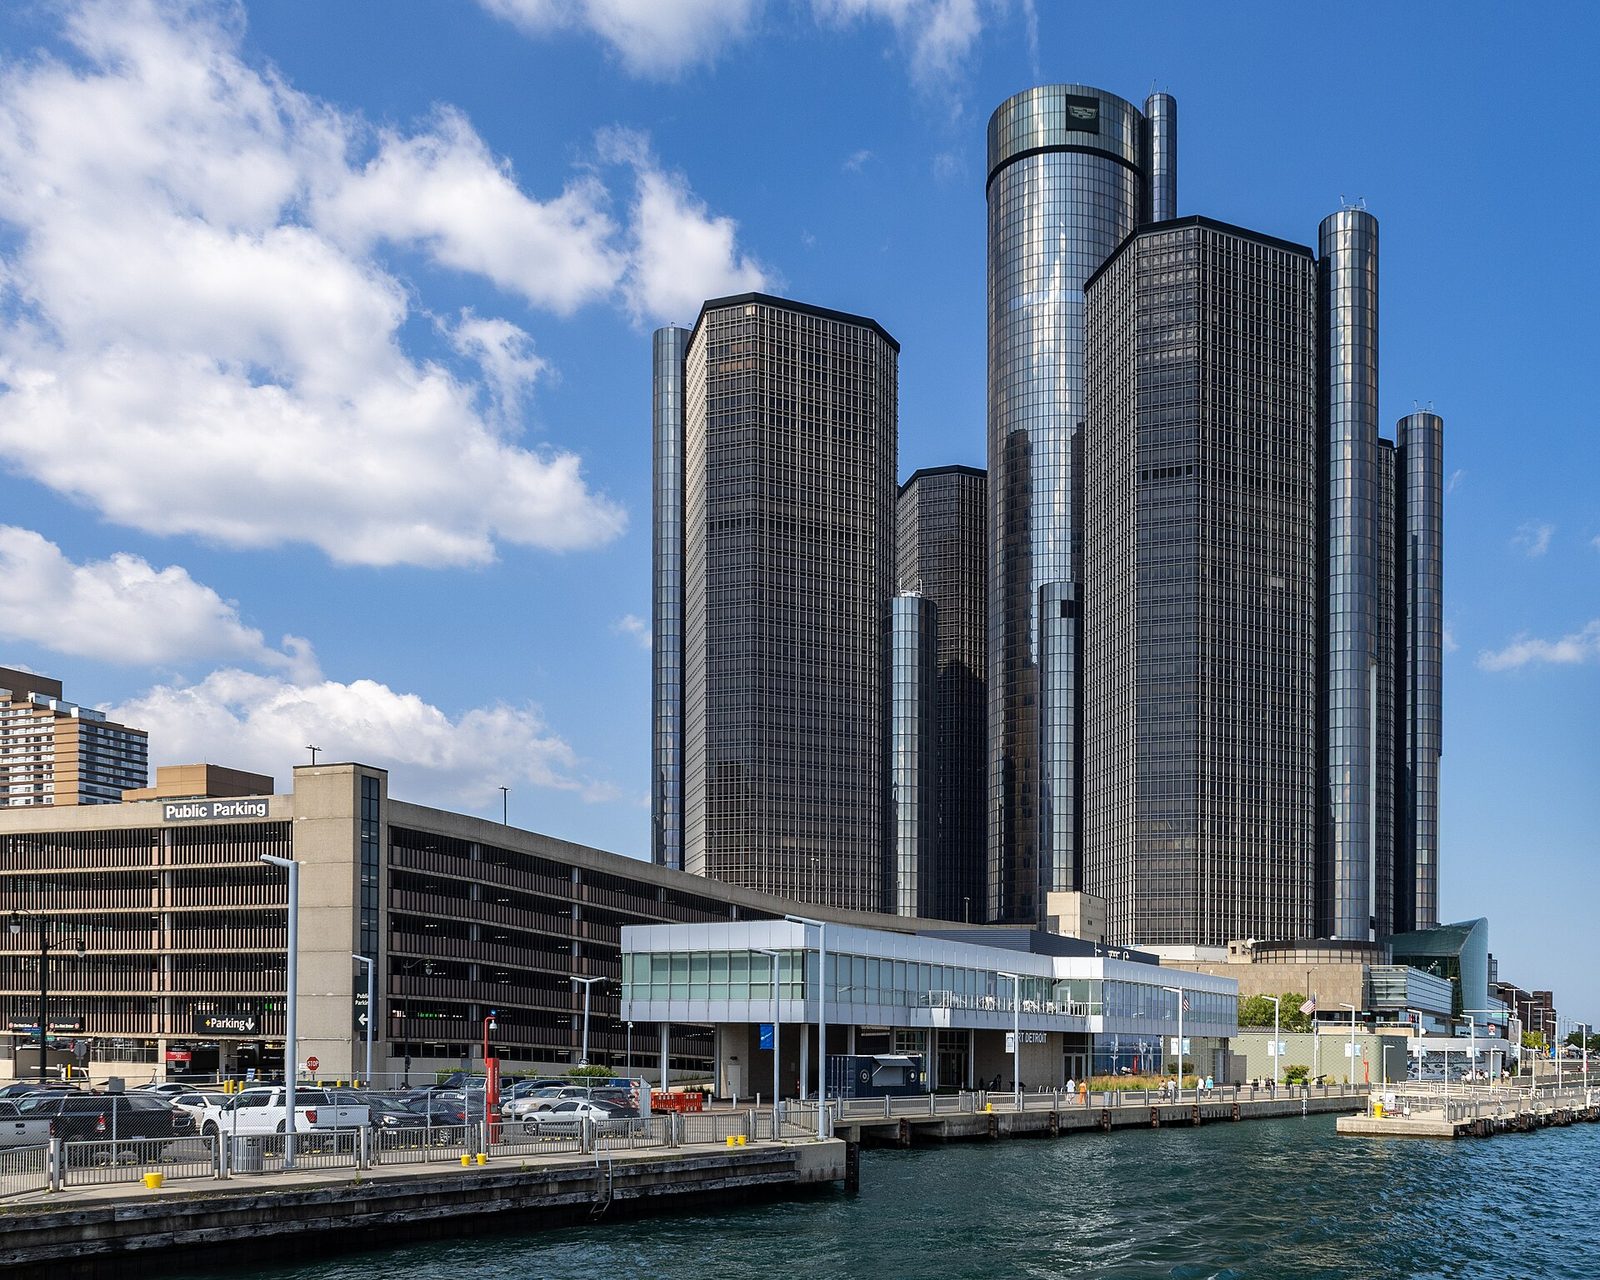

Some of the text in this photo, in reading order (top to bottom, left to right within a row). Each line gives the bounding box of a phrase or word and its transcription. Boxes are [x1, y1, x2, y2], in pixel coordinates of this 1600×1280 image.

[166, 802, 266, 818] Public Parking
[211, 1017, 245, 1031] Parking
[1025, 1032, 1047, 1043] DETROIT
